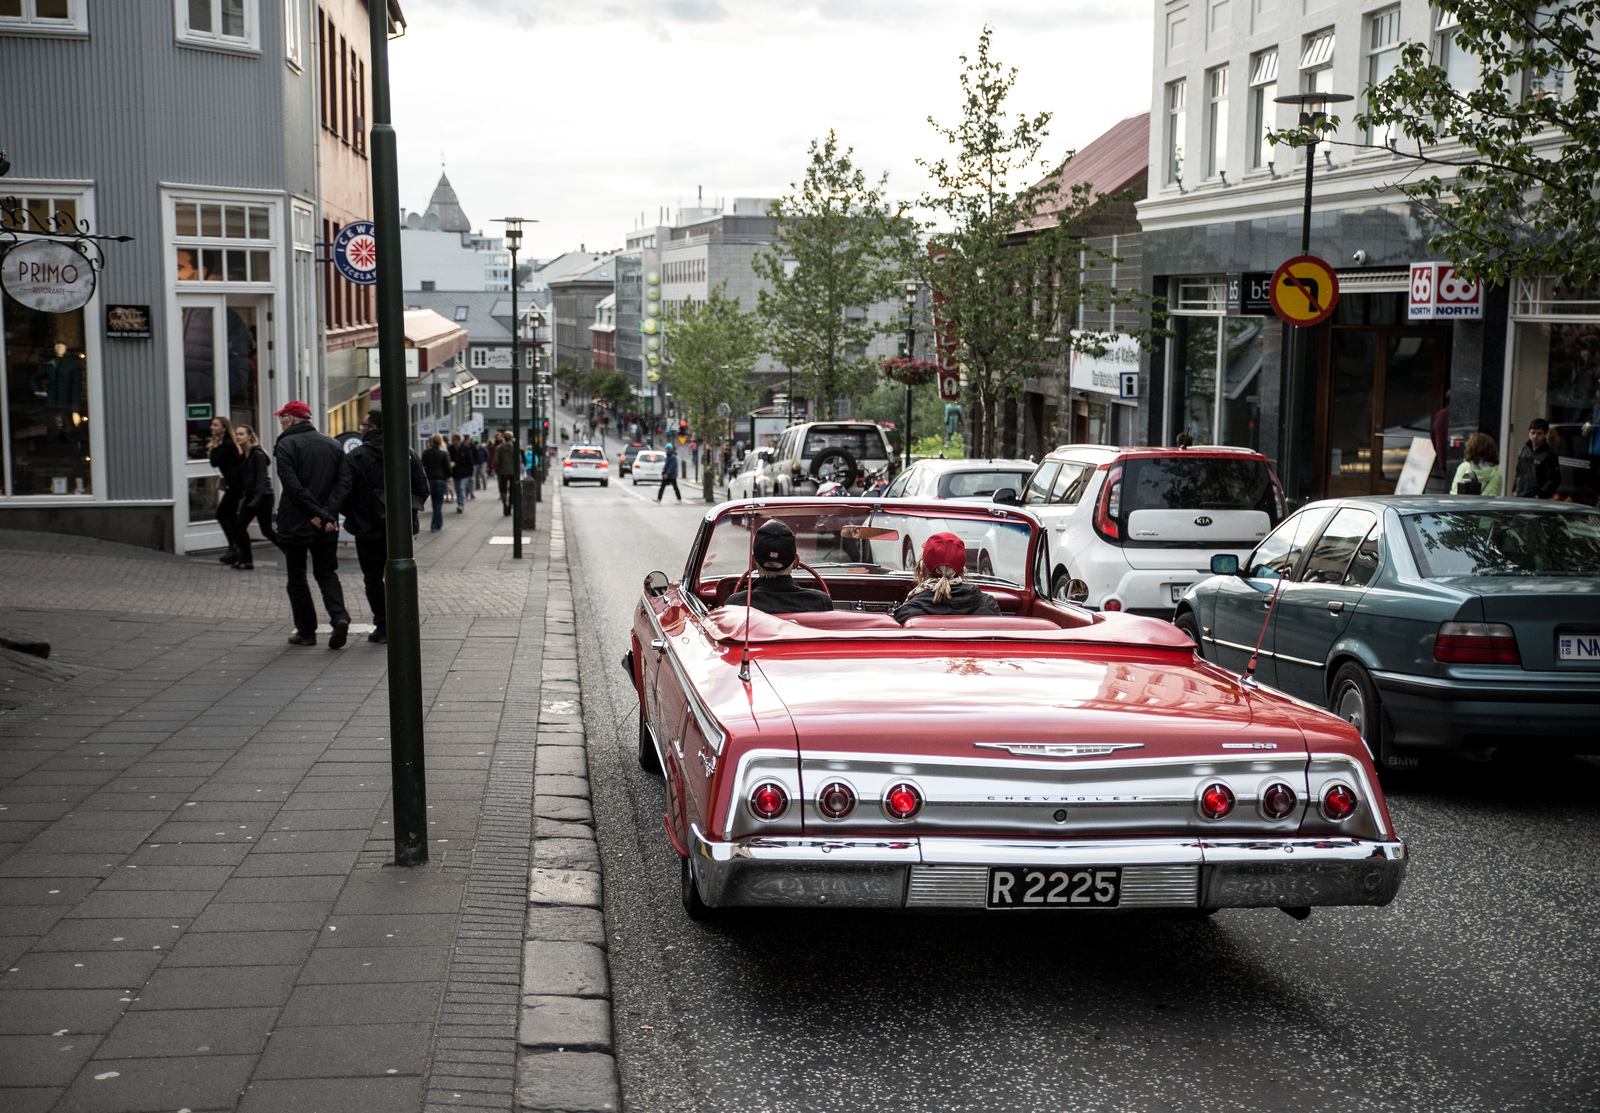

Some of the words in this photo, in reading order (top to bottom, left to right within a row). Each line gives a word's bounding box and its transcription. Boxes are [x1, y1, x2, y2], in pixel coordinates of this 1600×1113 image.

[19, 261, 79, 284] PRIMO
[1251, 280, 1271, 300] b5
[1411, 306, 1431, 315] NORTH
[1436, 306, 1479, 315] NORTH
[1561, 648, 1571, 656] IS
[1388, 756, 1419, 766] BMW
[992, 871, 1015, 903] R
[1023, 871, 1117, 903] 2225
